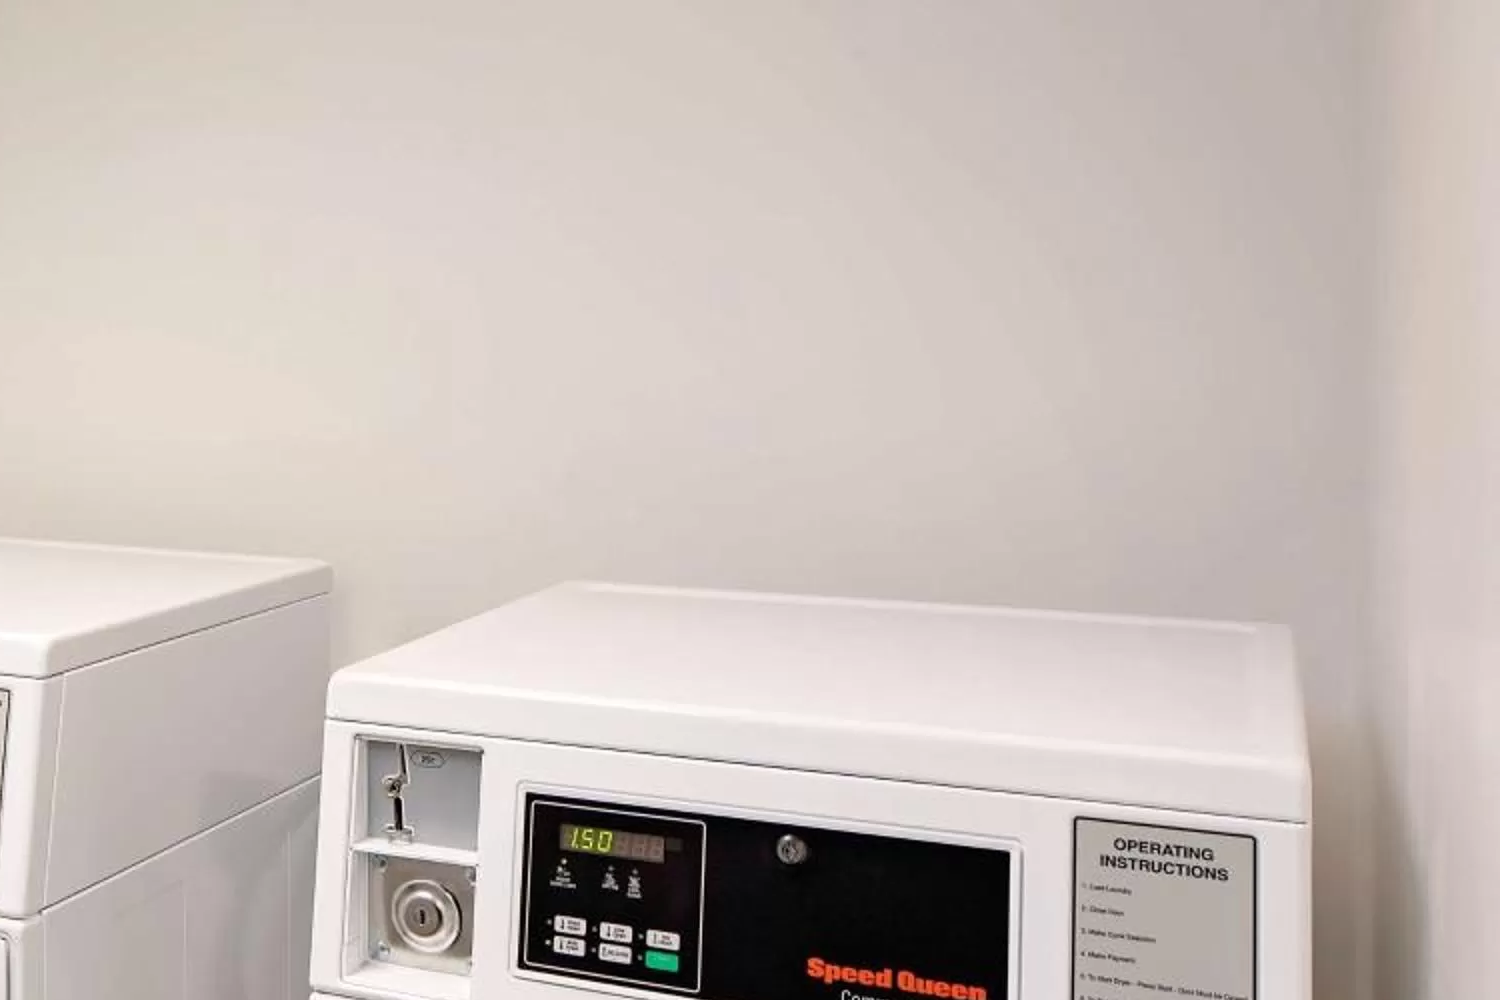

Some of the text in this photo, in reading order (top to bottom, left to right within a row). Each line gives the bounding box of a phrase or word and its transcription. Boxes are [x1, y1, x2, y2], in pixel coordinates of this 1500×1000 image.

[1113, 837, 1214, 861] OPERATING
[1100, 854, 1229, 881] INSTRUCTIONS
[807, 956, 893, 988] Speed
